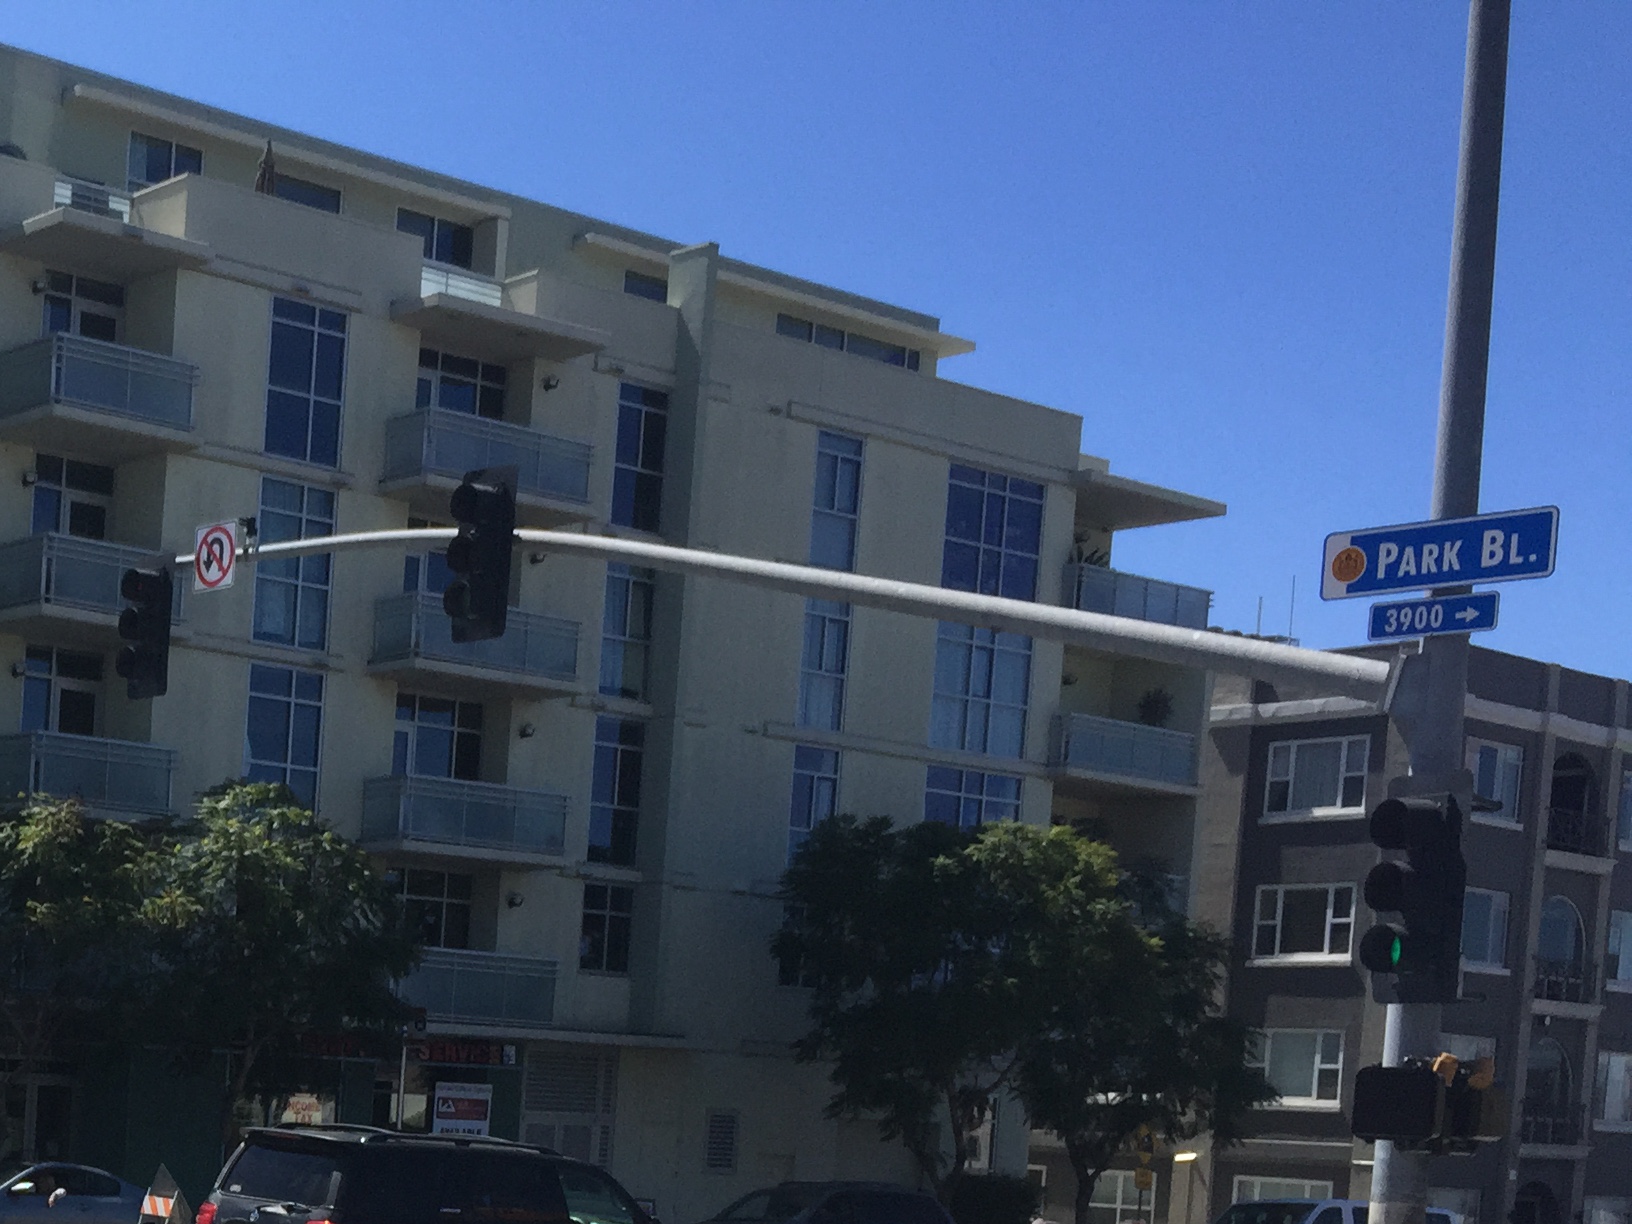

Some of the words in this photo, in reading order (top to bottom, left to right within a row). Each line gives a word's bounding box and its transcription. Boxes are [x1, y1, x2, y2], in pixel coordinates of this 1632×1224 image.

[1376, 539, 1463, 580] PARK
[1480, 529, 1538, 568] BL.
[1384, 604, 1443, 633] 3900
